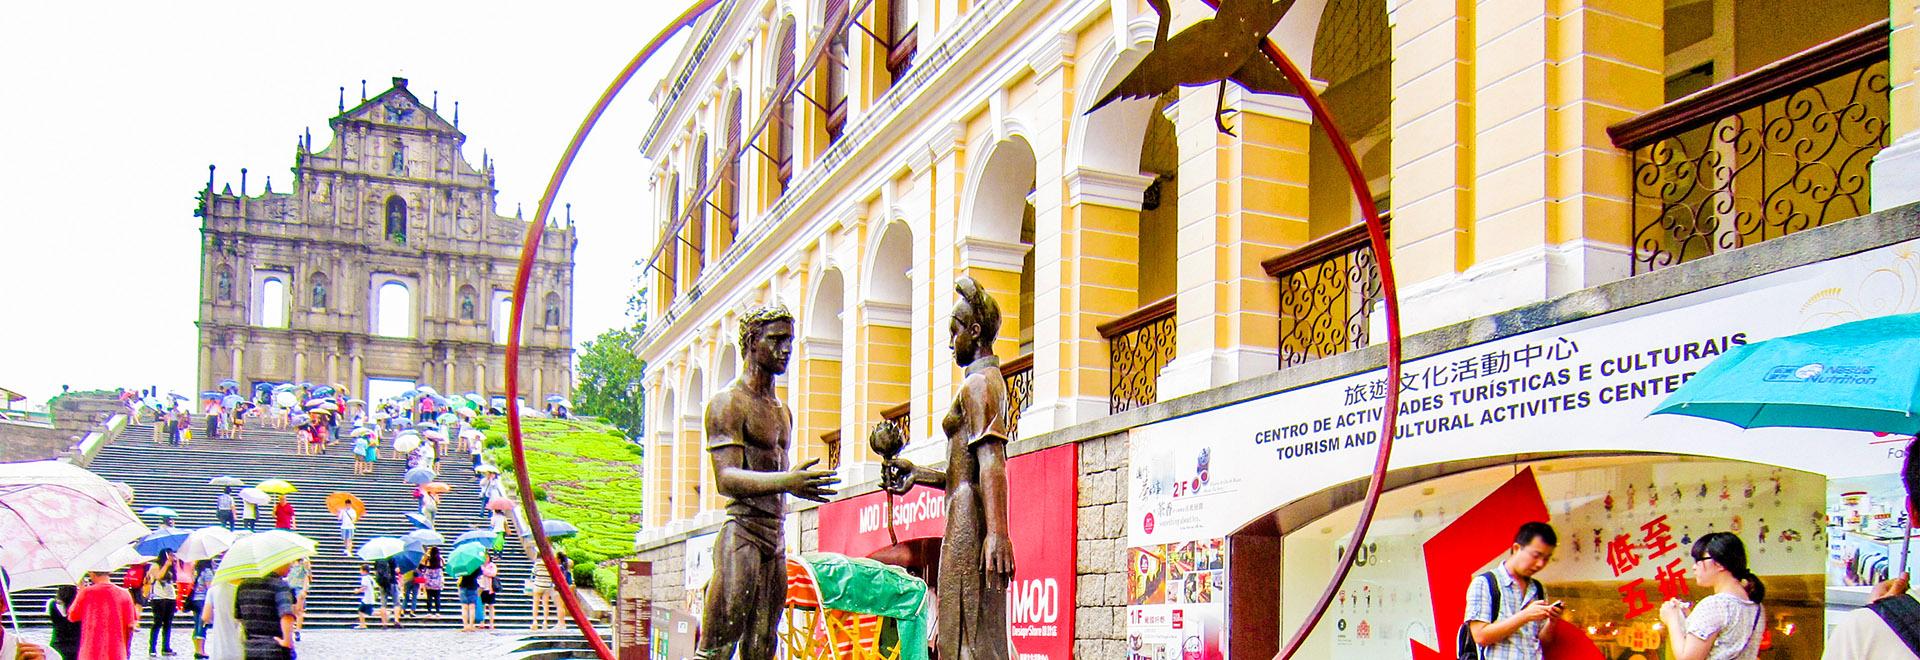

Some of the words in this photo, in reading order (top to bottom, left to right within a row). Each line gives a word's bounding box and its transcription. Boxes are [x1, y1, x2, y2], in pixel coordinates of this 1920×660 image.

[1255, 422, 1308, 445] CENTRO
[1313, 416, 1331, 433] DE
[1336, 394, 1443, 429] ACTIVADES
[1450, 367, 1570, 406] TURÍSTICAS
[1578, 363, 1592, 381] E
[1600, 332, 1748, 377] CULTURAIS
[1344, 336, 1579, 406] 旅遊文化活動中心
[1806, 374, 1877, 385] Nutrition
[1277, 436, 1340, 461] TOURISM
[1344, 430, 1377, 449] AND
[1394, 412, 1474, 440] ULTURAL
[1480, 391, 1590, 425] ACTIVITES
[859, 503, 880, 534] MOD
[1012, 578, 1058, 623] MOD
